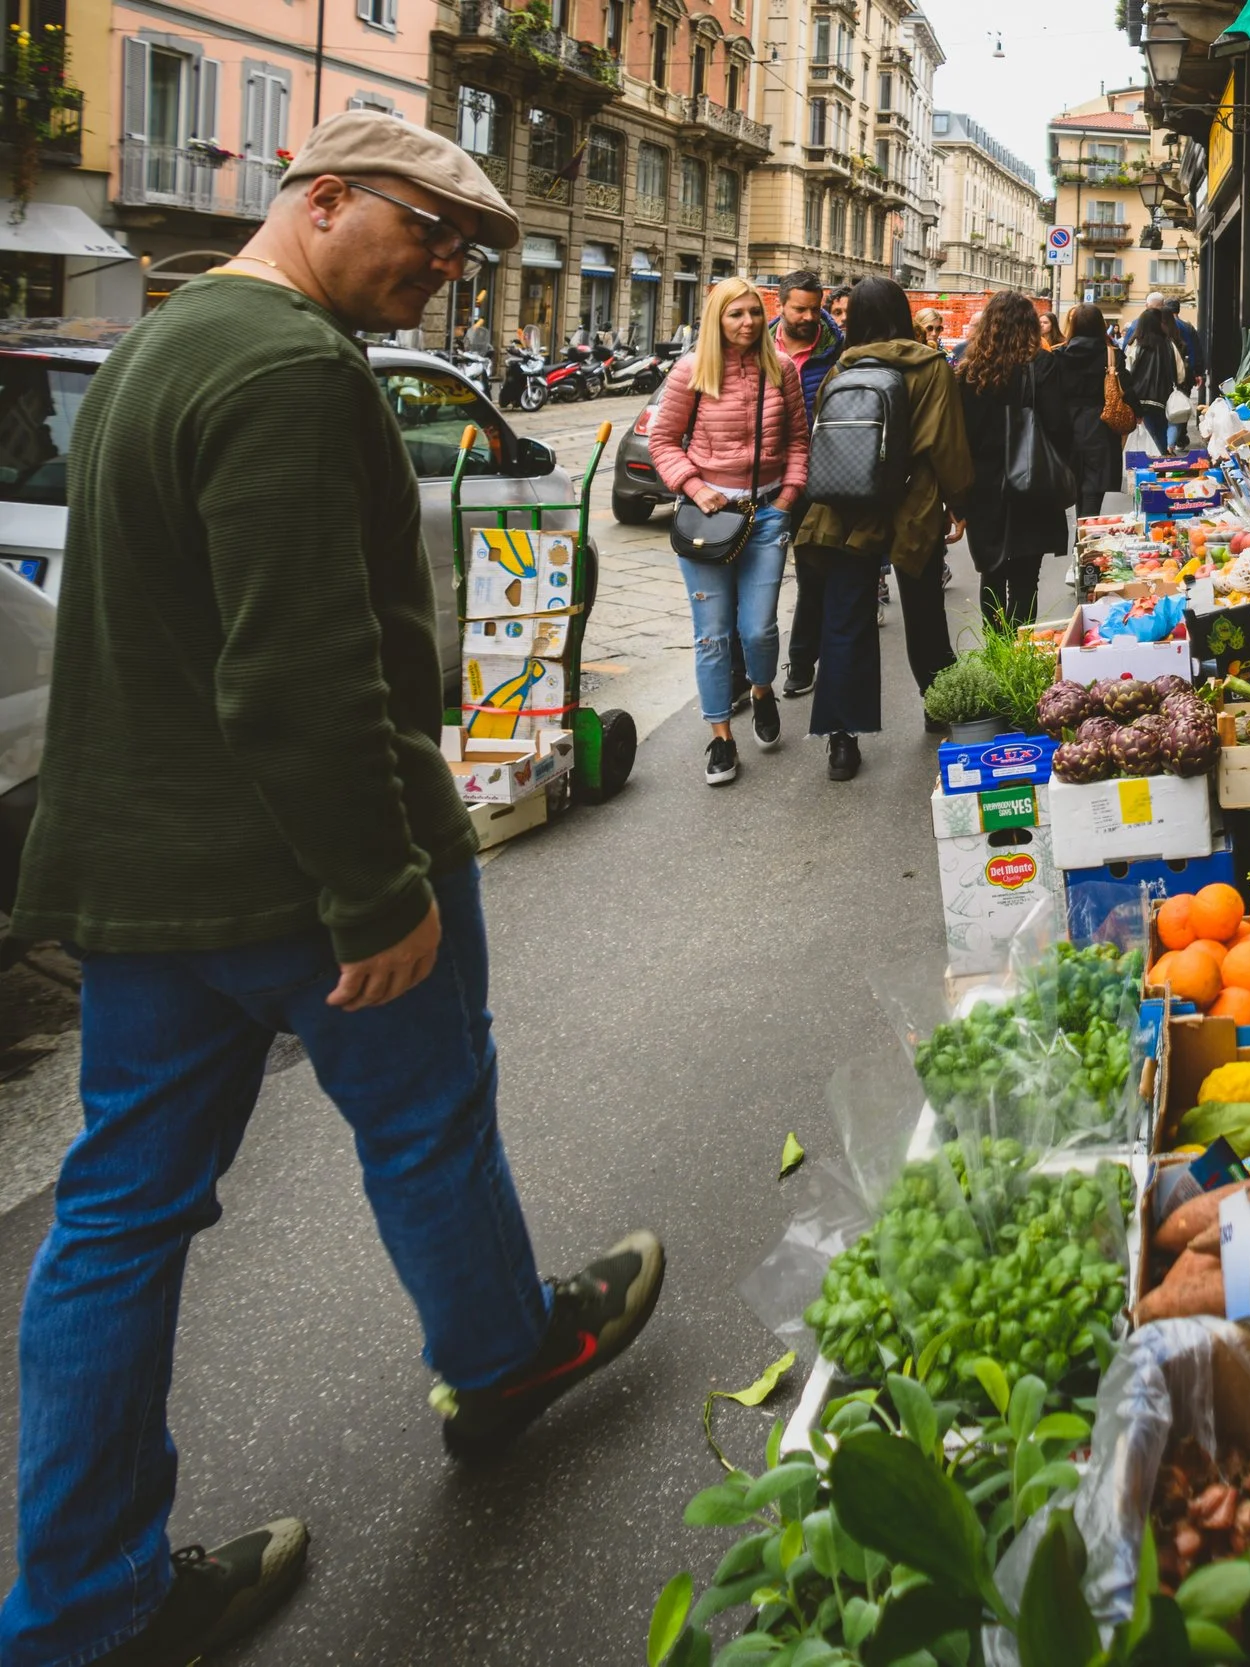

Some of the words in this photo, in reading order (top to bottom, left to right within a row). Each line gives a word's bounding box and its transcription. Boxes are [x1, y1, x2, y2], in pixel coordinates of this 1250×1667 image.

[991, 748, 1035, 762] LUX
[982, 802, 1012, 812] EVERYBODY
[1012, 797, 1033, 816] YES
[990, 866, 1005, 877] Del
[1005, 862, 1033, 875] Monte
